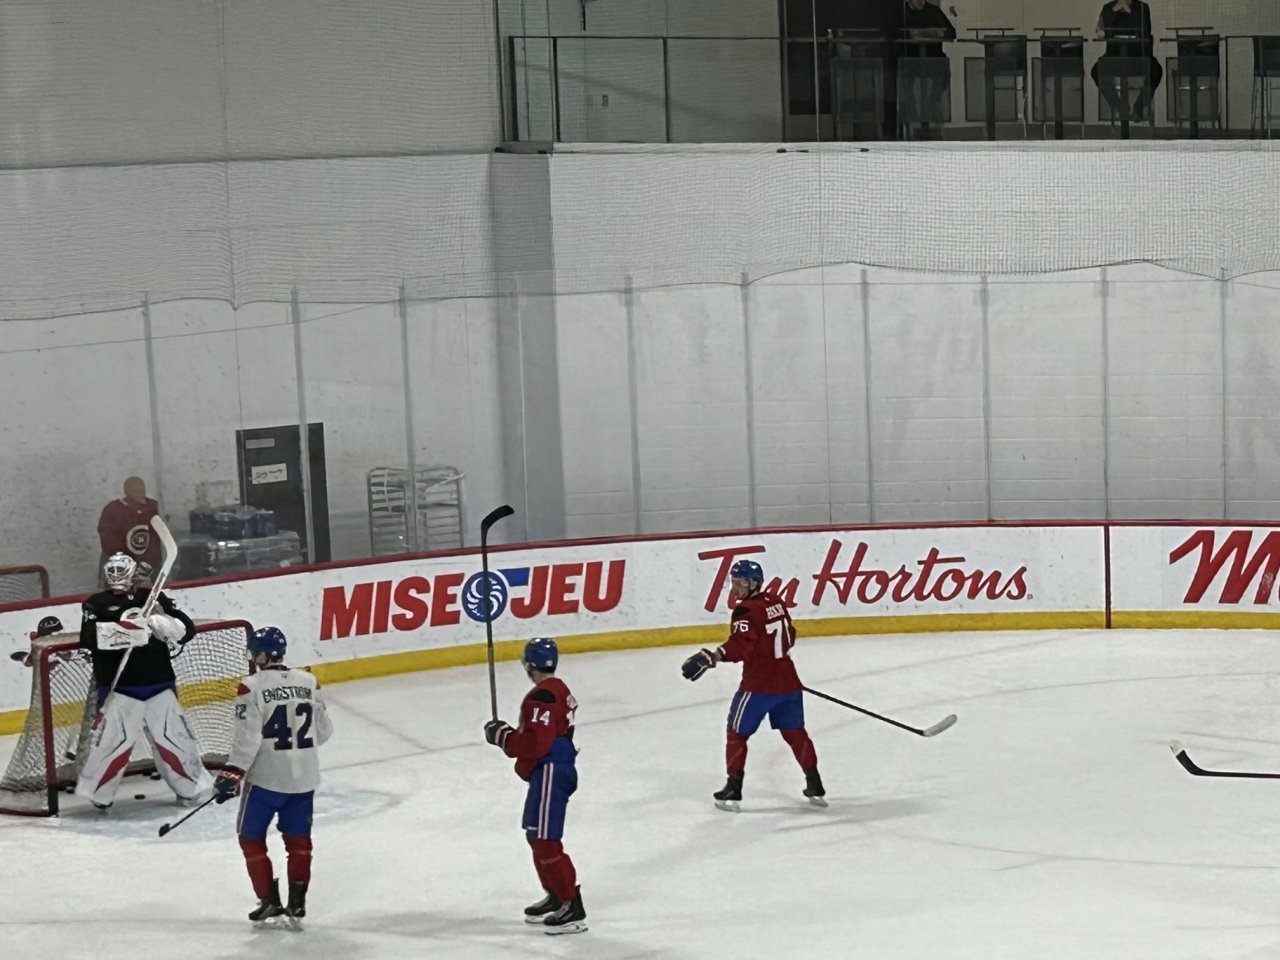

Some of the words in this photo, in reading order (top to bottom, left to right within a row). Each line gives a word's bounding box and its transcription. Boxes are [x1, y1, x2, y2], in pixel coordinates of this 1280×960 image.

[812, 539, 1027, 606] Hortons
[261, 702, 314, 750] 42
[531, 707, 550, 726] 14
